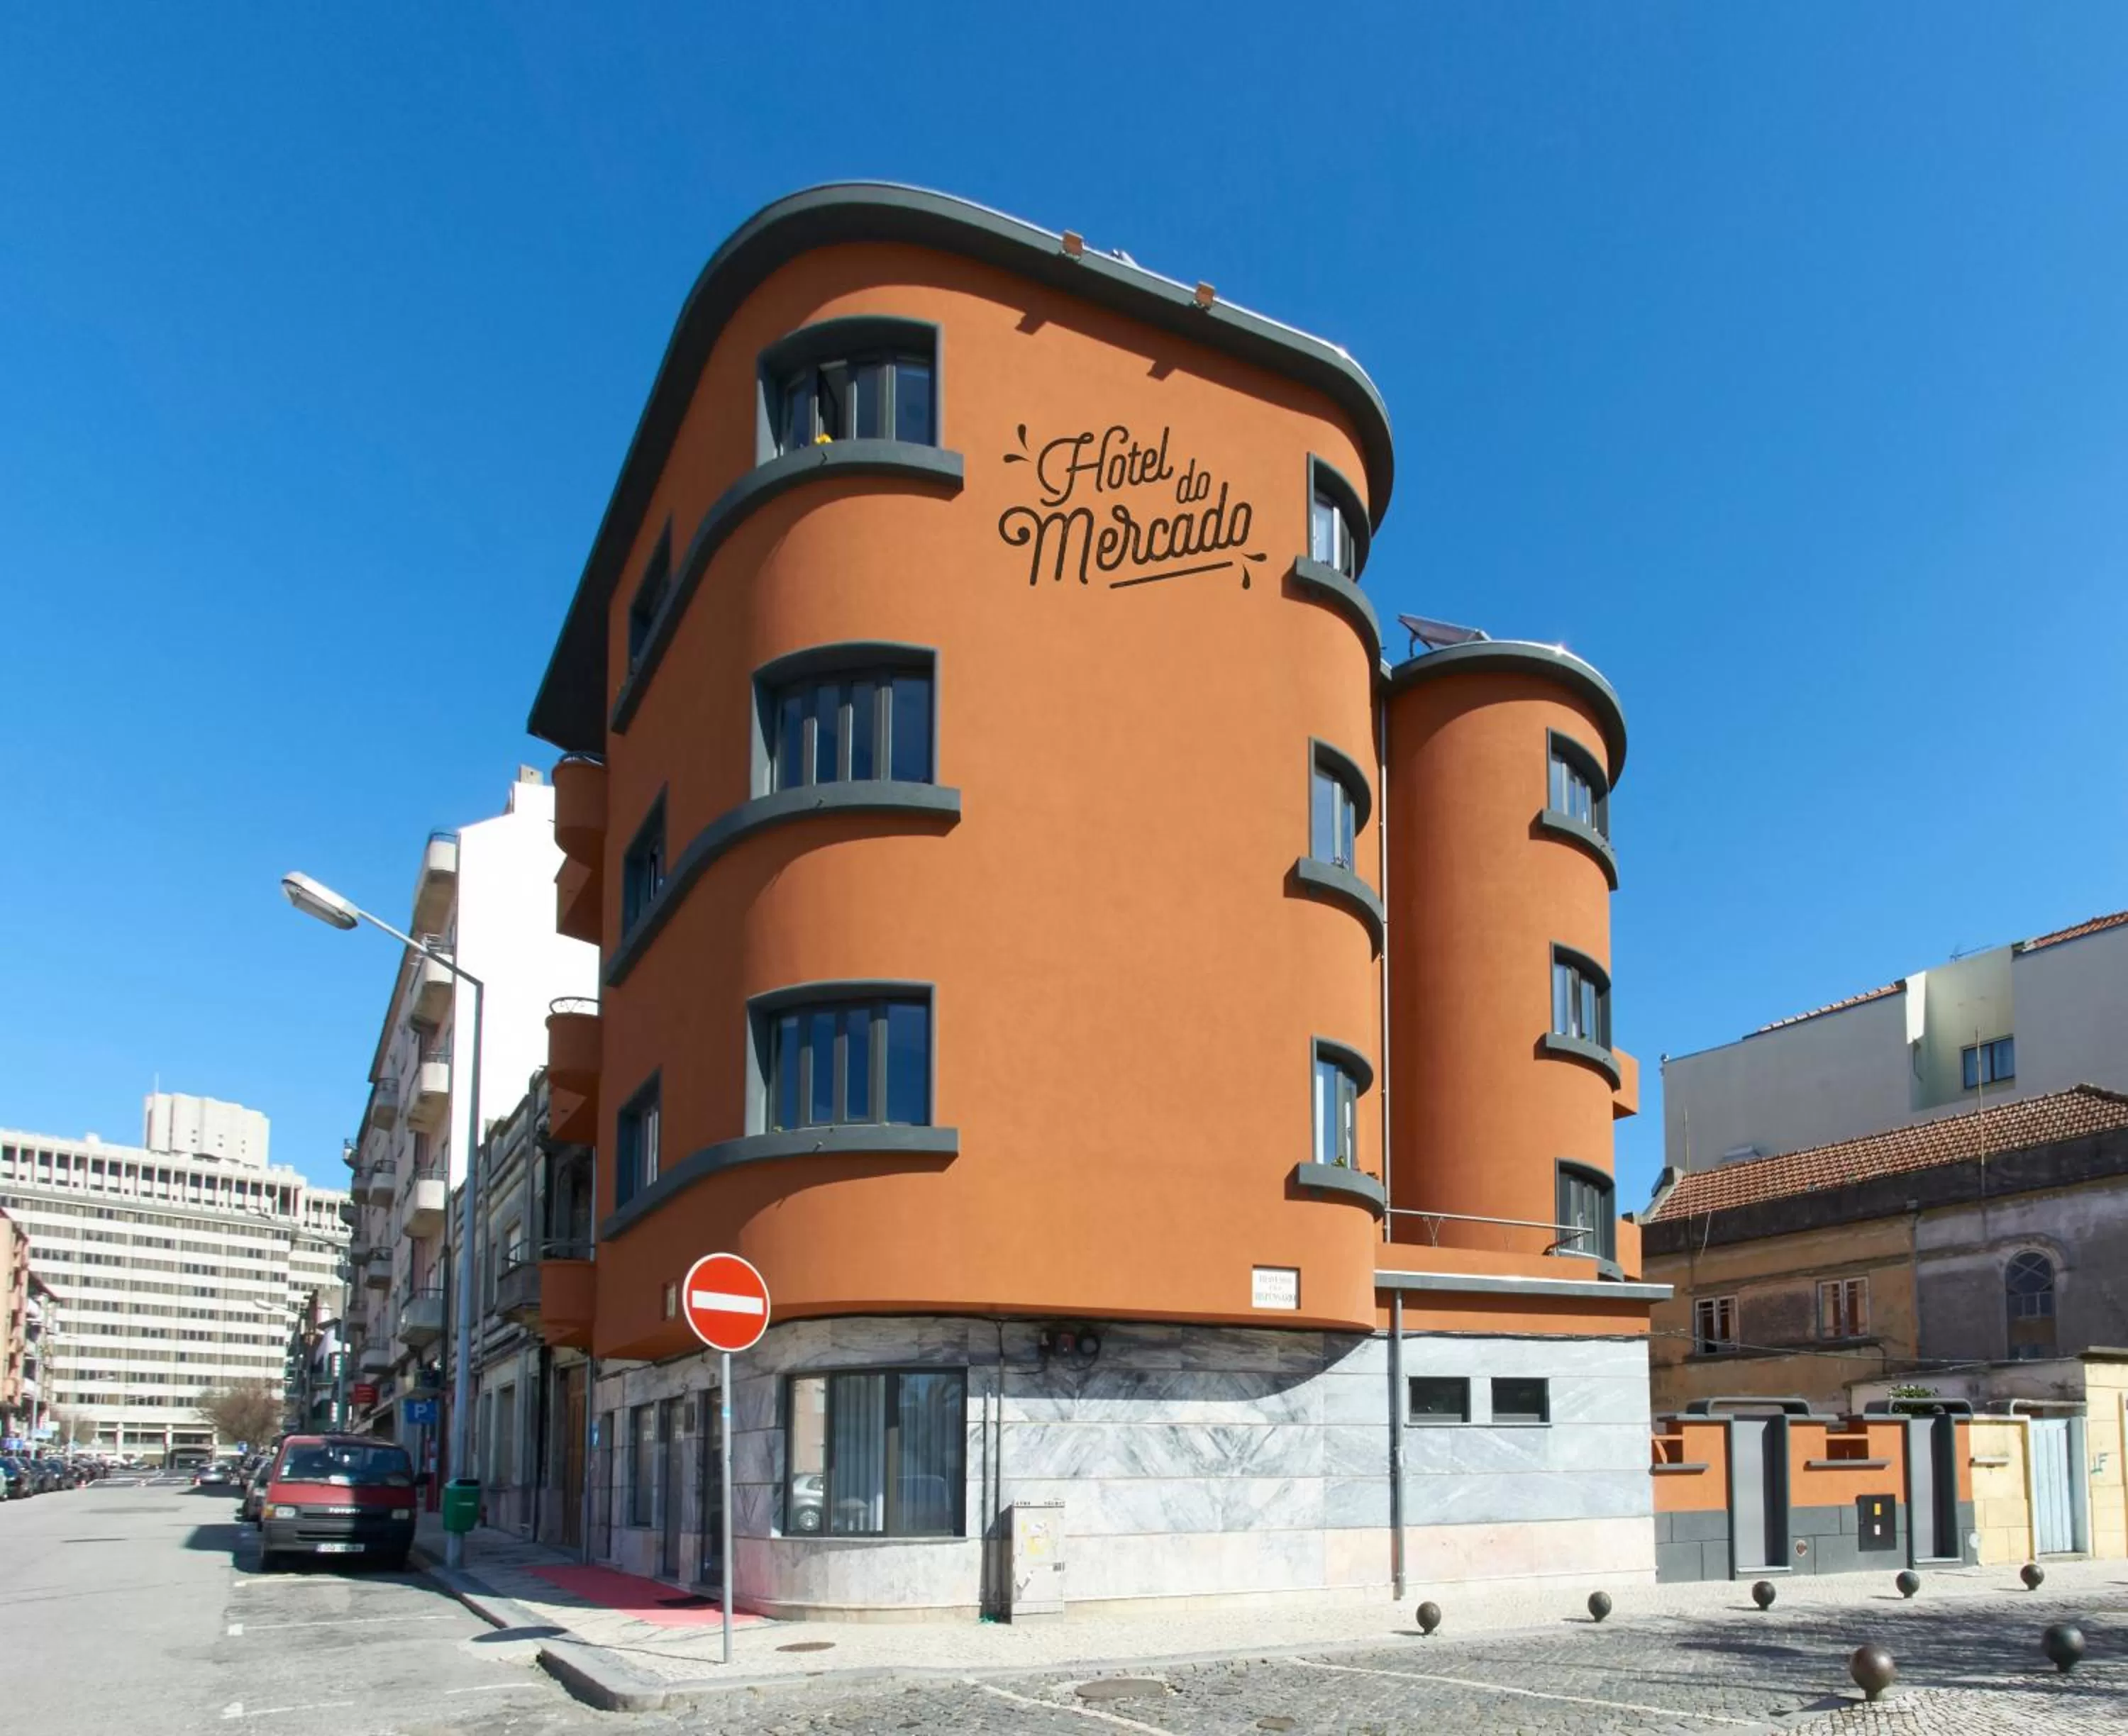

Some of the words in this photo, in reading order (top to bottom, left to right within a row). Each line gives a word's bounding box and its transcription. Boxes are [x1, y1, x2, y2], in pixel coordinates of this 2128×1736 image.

[1037, 425, 1174, 507] Hotel
[1175, 458, 1212, 504] do
[998, 482, 1253, 586] Mercado
[414, 1403, 428, 1419] P
